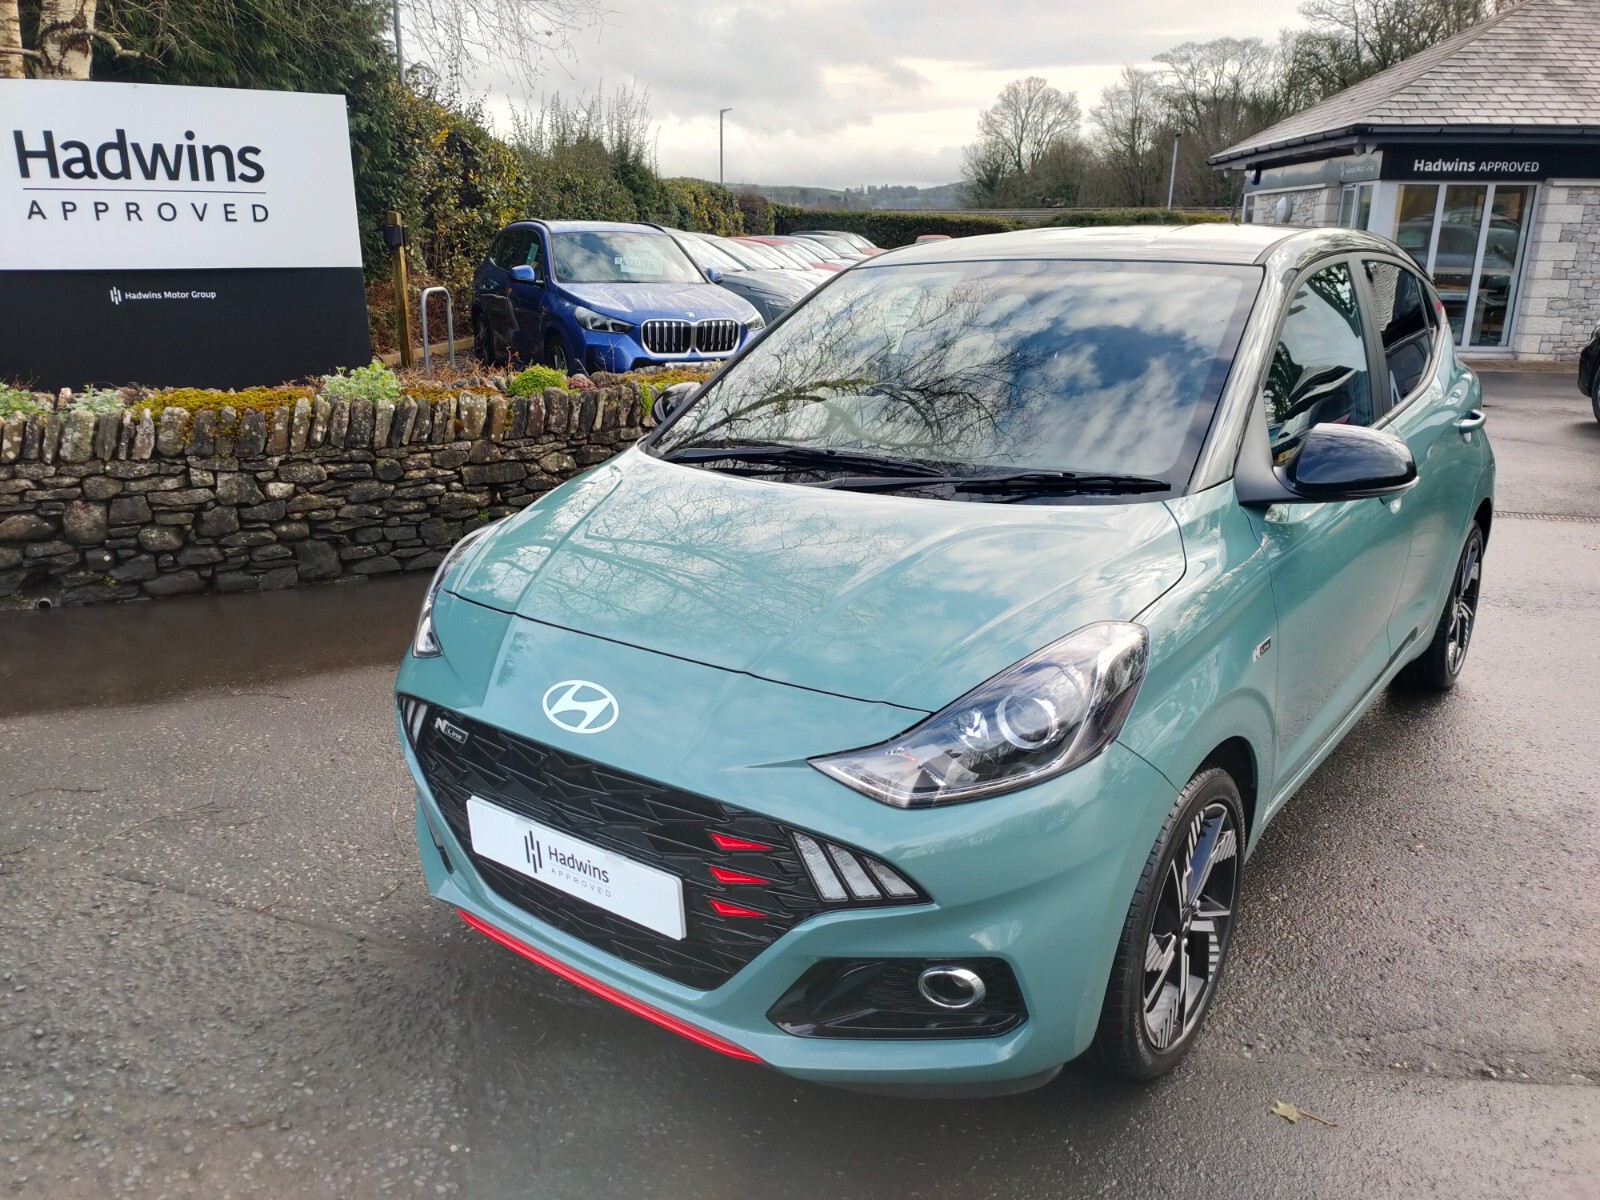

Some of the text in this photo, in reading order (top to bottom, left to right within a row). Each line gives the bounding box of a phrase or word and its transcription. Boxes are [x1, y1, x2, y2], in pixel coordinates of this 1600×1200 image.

[13, 128, 265, 184] Hadwins
[1413, 158, 1540, 173] Hadwins APPROVED
[27, 199, 269, 223] APPROVED
[124, 290, 217, 300] Hadwins Motor Group
[548, 844, 610, 884] Hadwins
[551, 867, 612, 898] APPROVED
